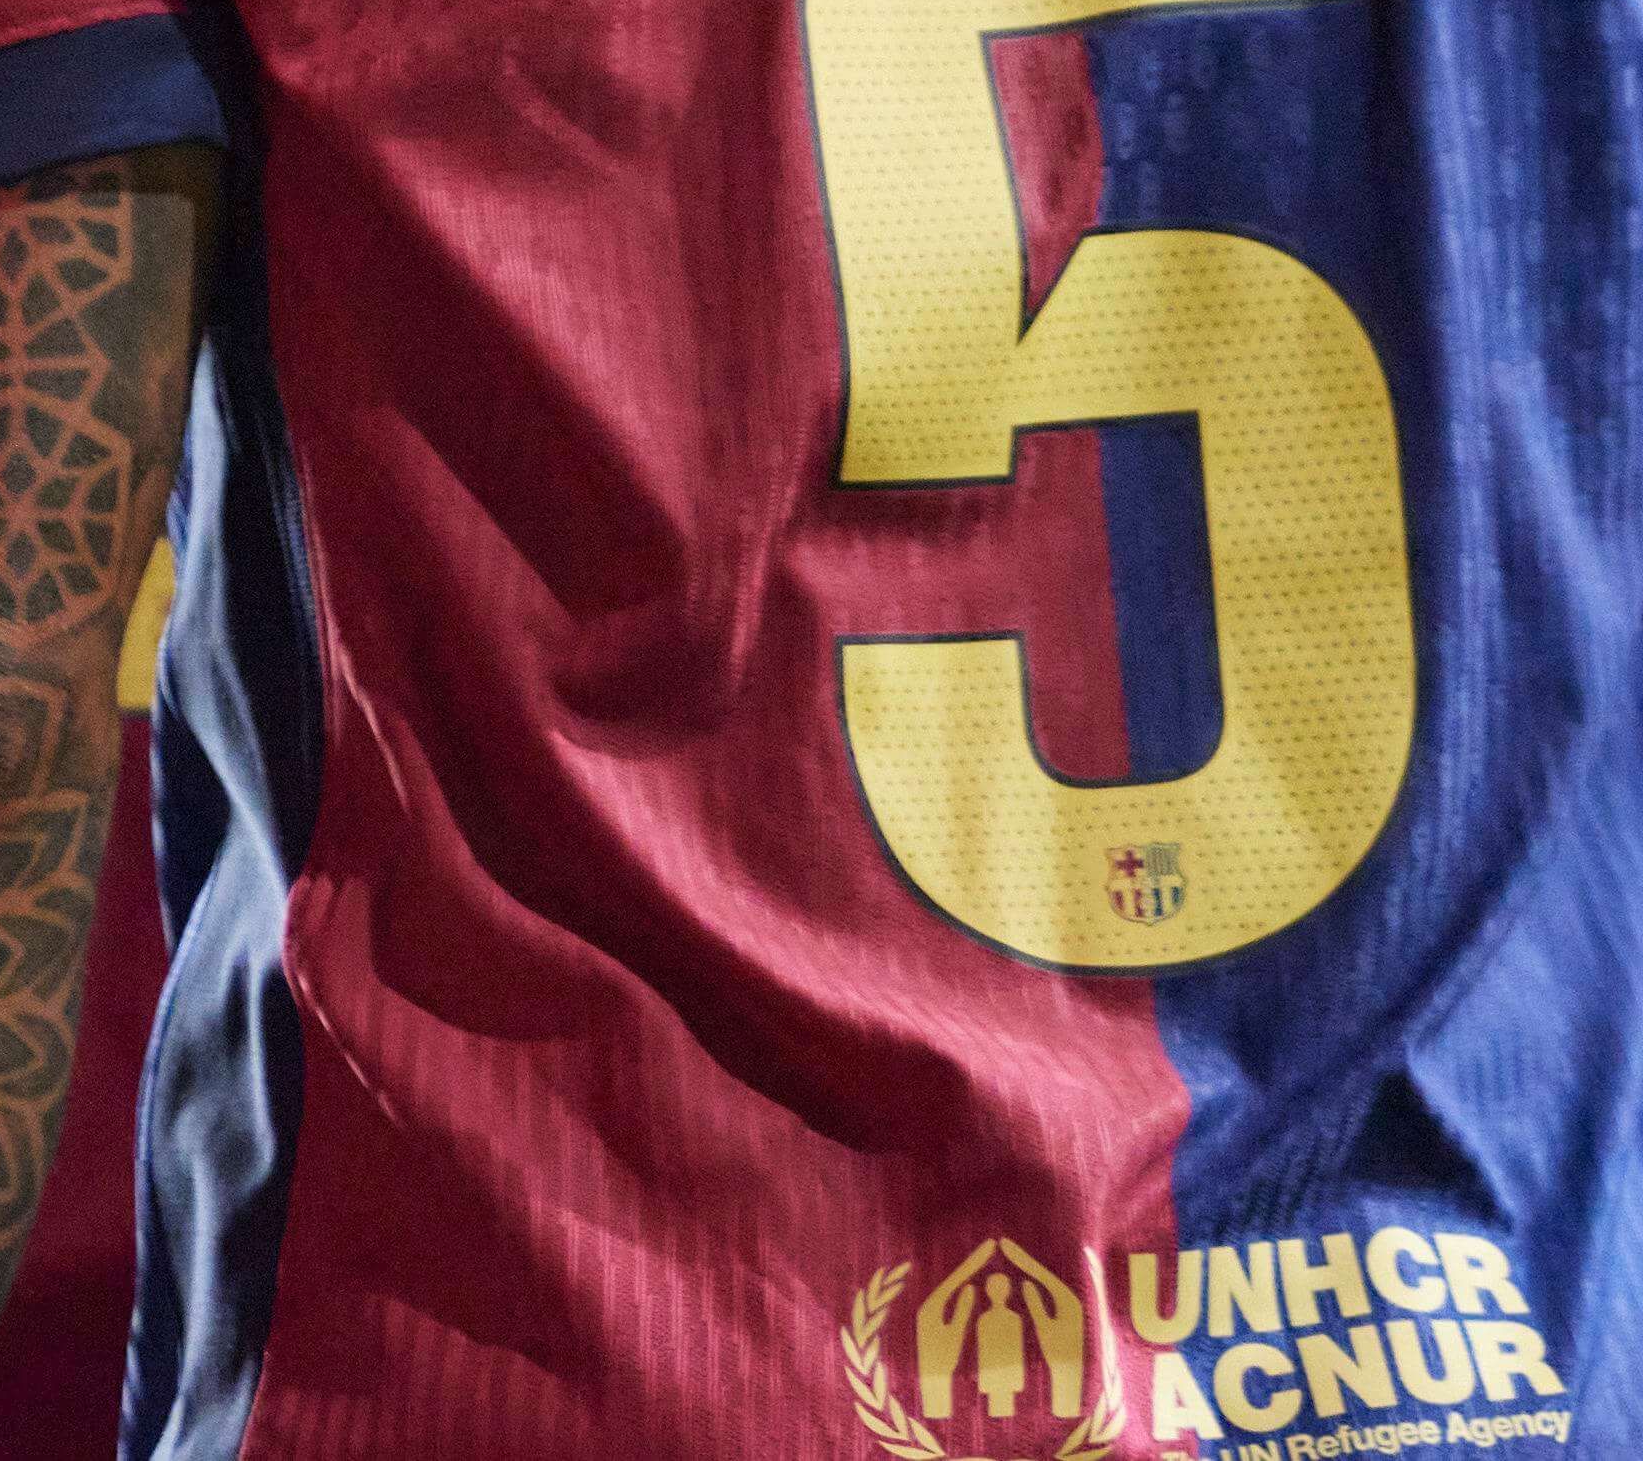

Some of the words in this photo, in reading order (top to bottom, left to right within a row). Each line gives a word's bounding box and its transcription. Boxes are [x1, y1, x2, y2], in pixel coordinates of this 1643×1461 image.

[1127, 1226, 1531, 1346] UNHCR
[1150, 1319, 1567, 1442] ACNUR
[1284, 1421, 1441, 1461] Refugee
[1446, 1409, 1572, 1447] Agency
